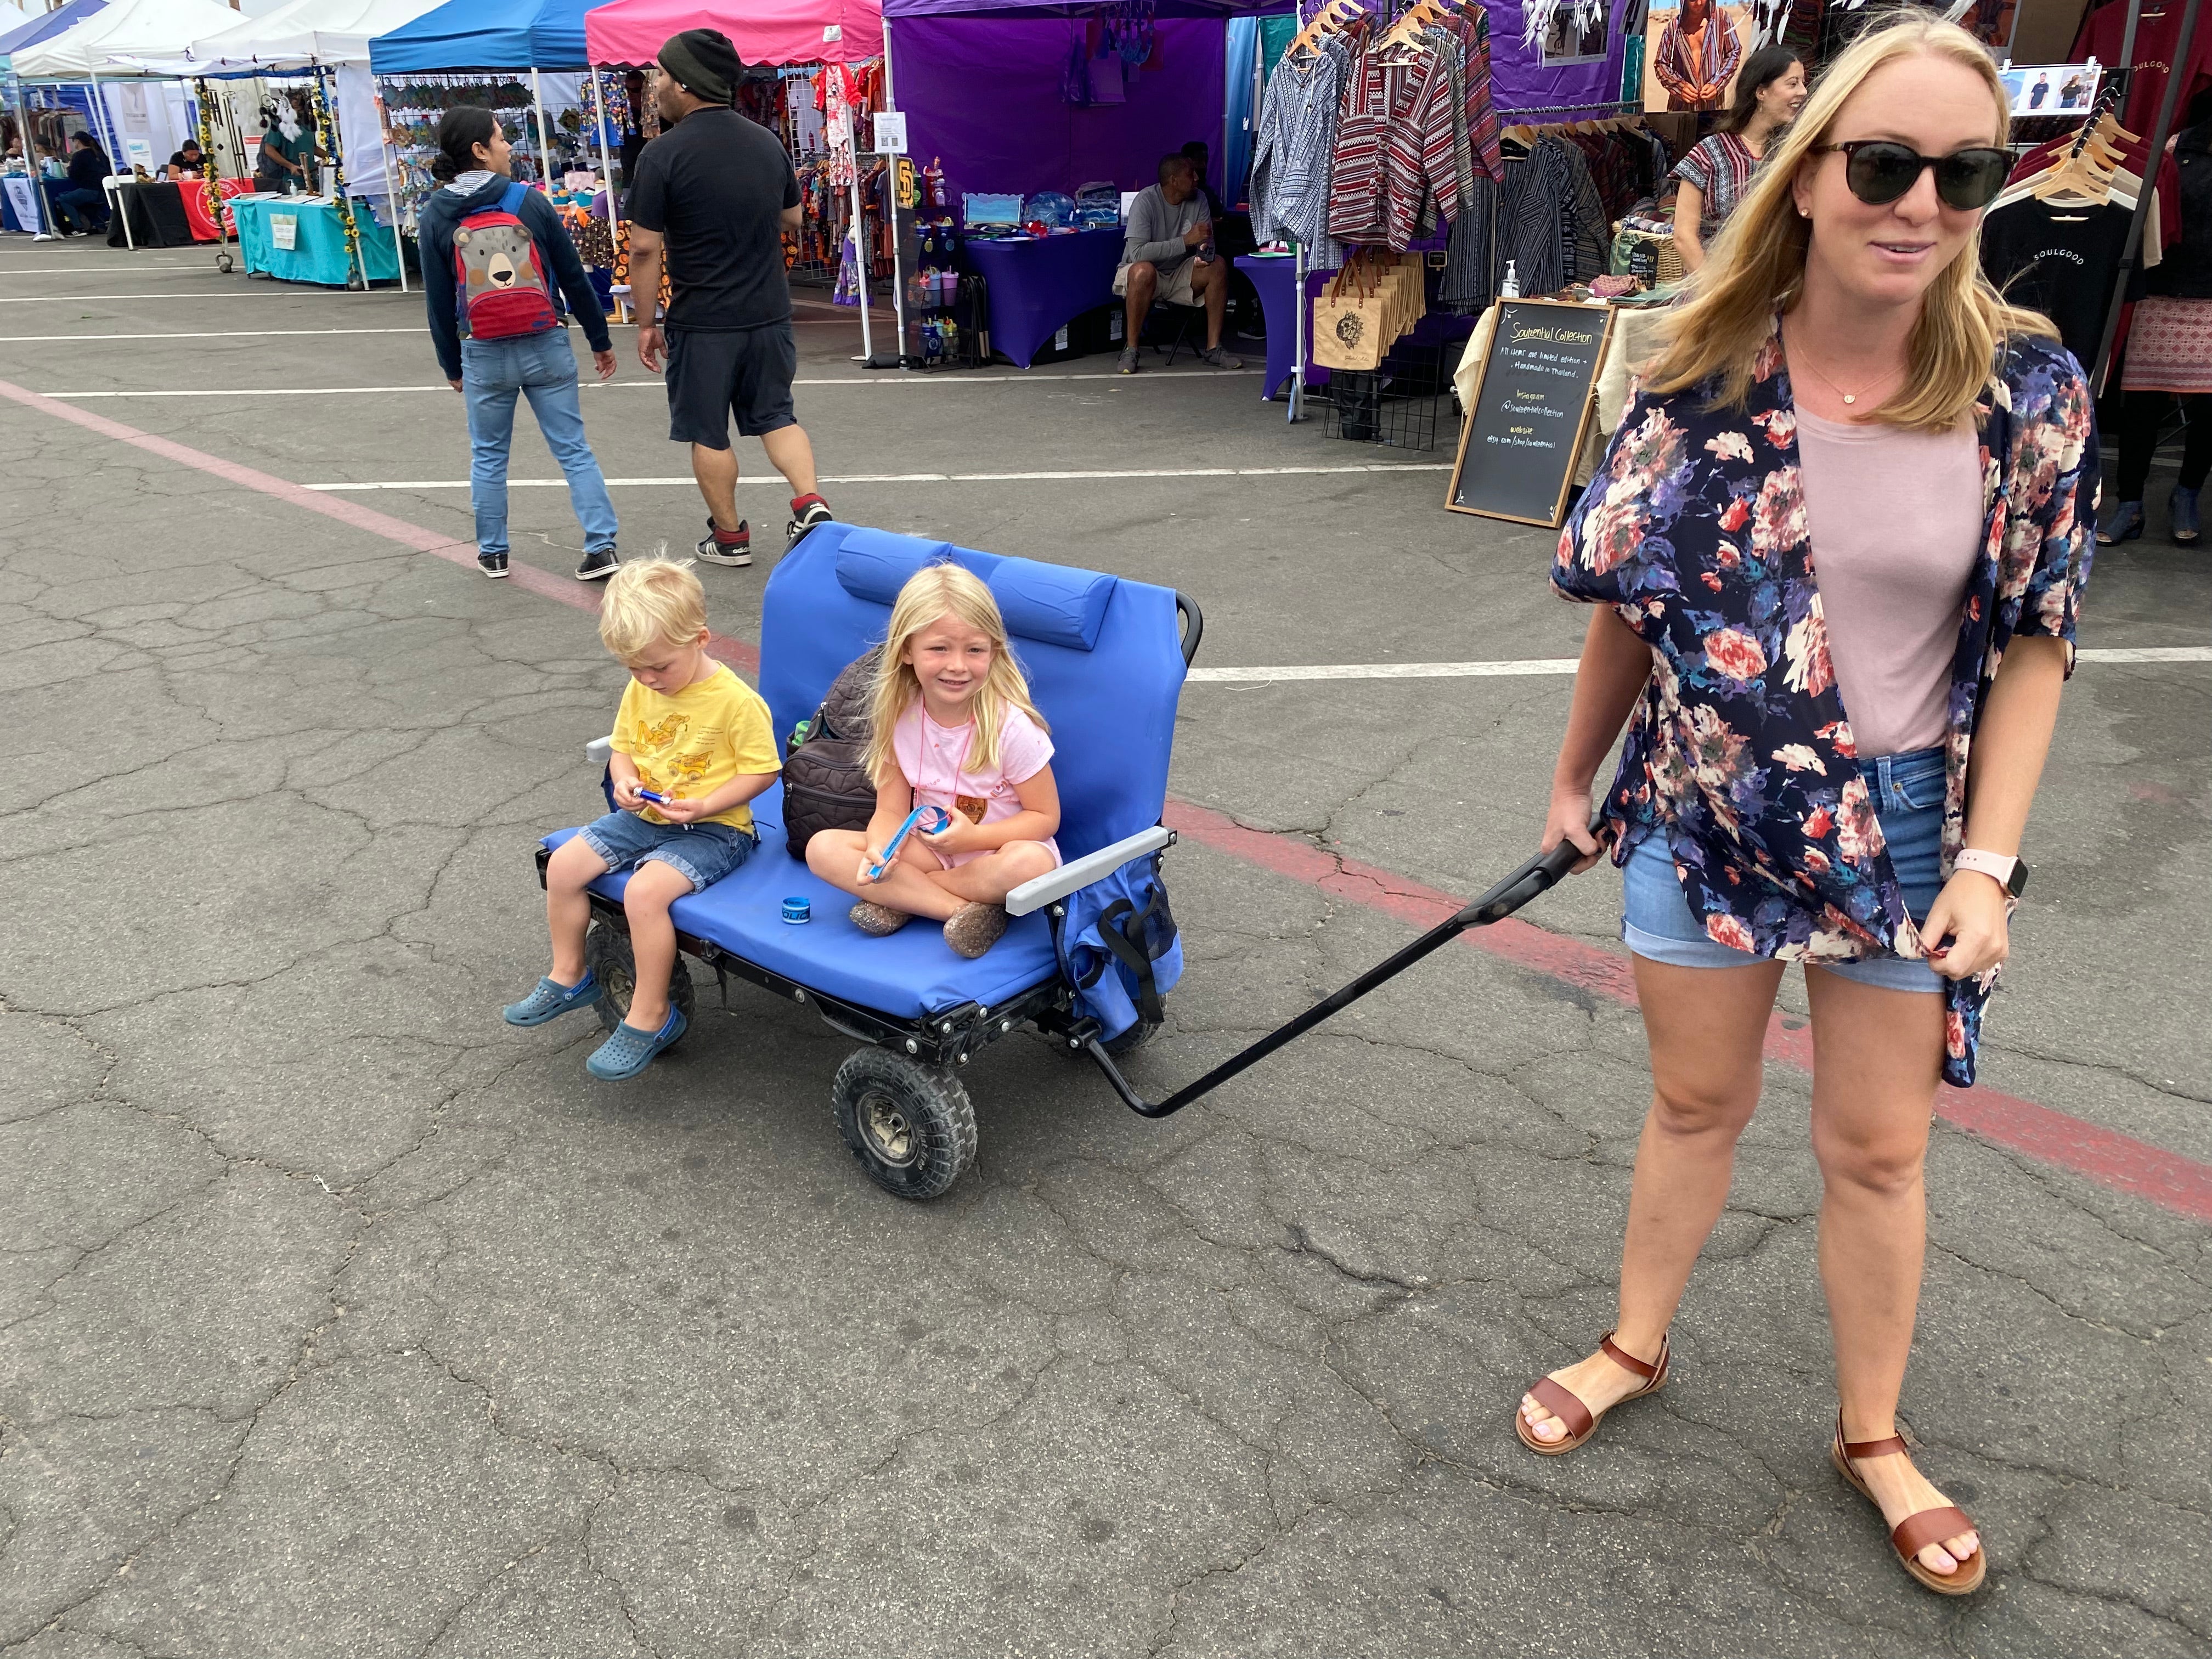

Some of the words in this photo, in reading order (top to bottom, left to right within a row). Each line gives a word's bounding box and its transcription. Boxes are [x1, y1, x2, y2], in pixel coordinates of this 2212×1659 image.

[2034, 249, 2084, 265] SOULGOOD
[1555, 328, 1593, 344] Collection
[1560, 356, 1581, 365] edition
[782, 909, 810, 920] OLIC
